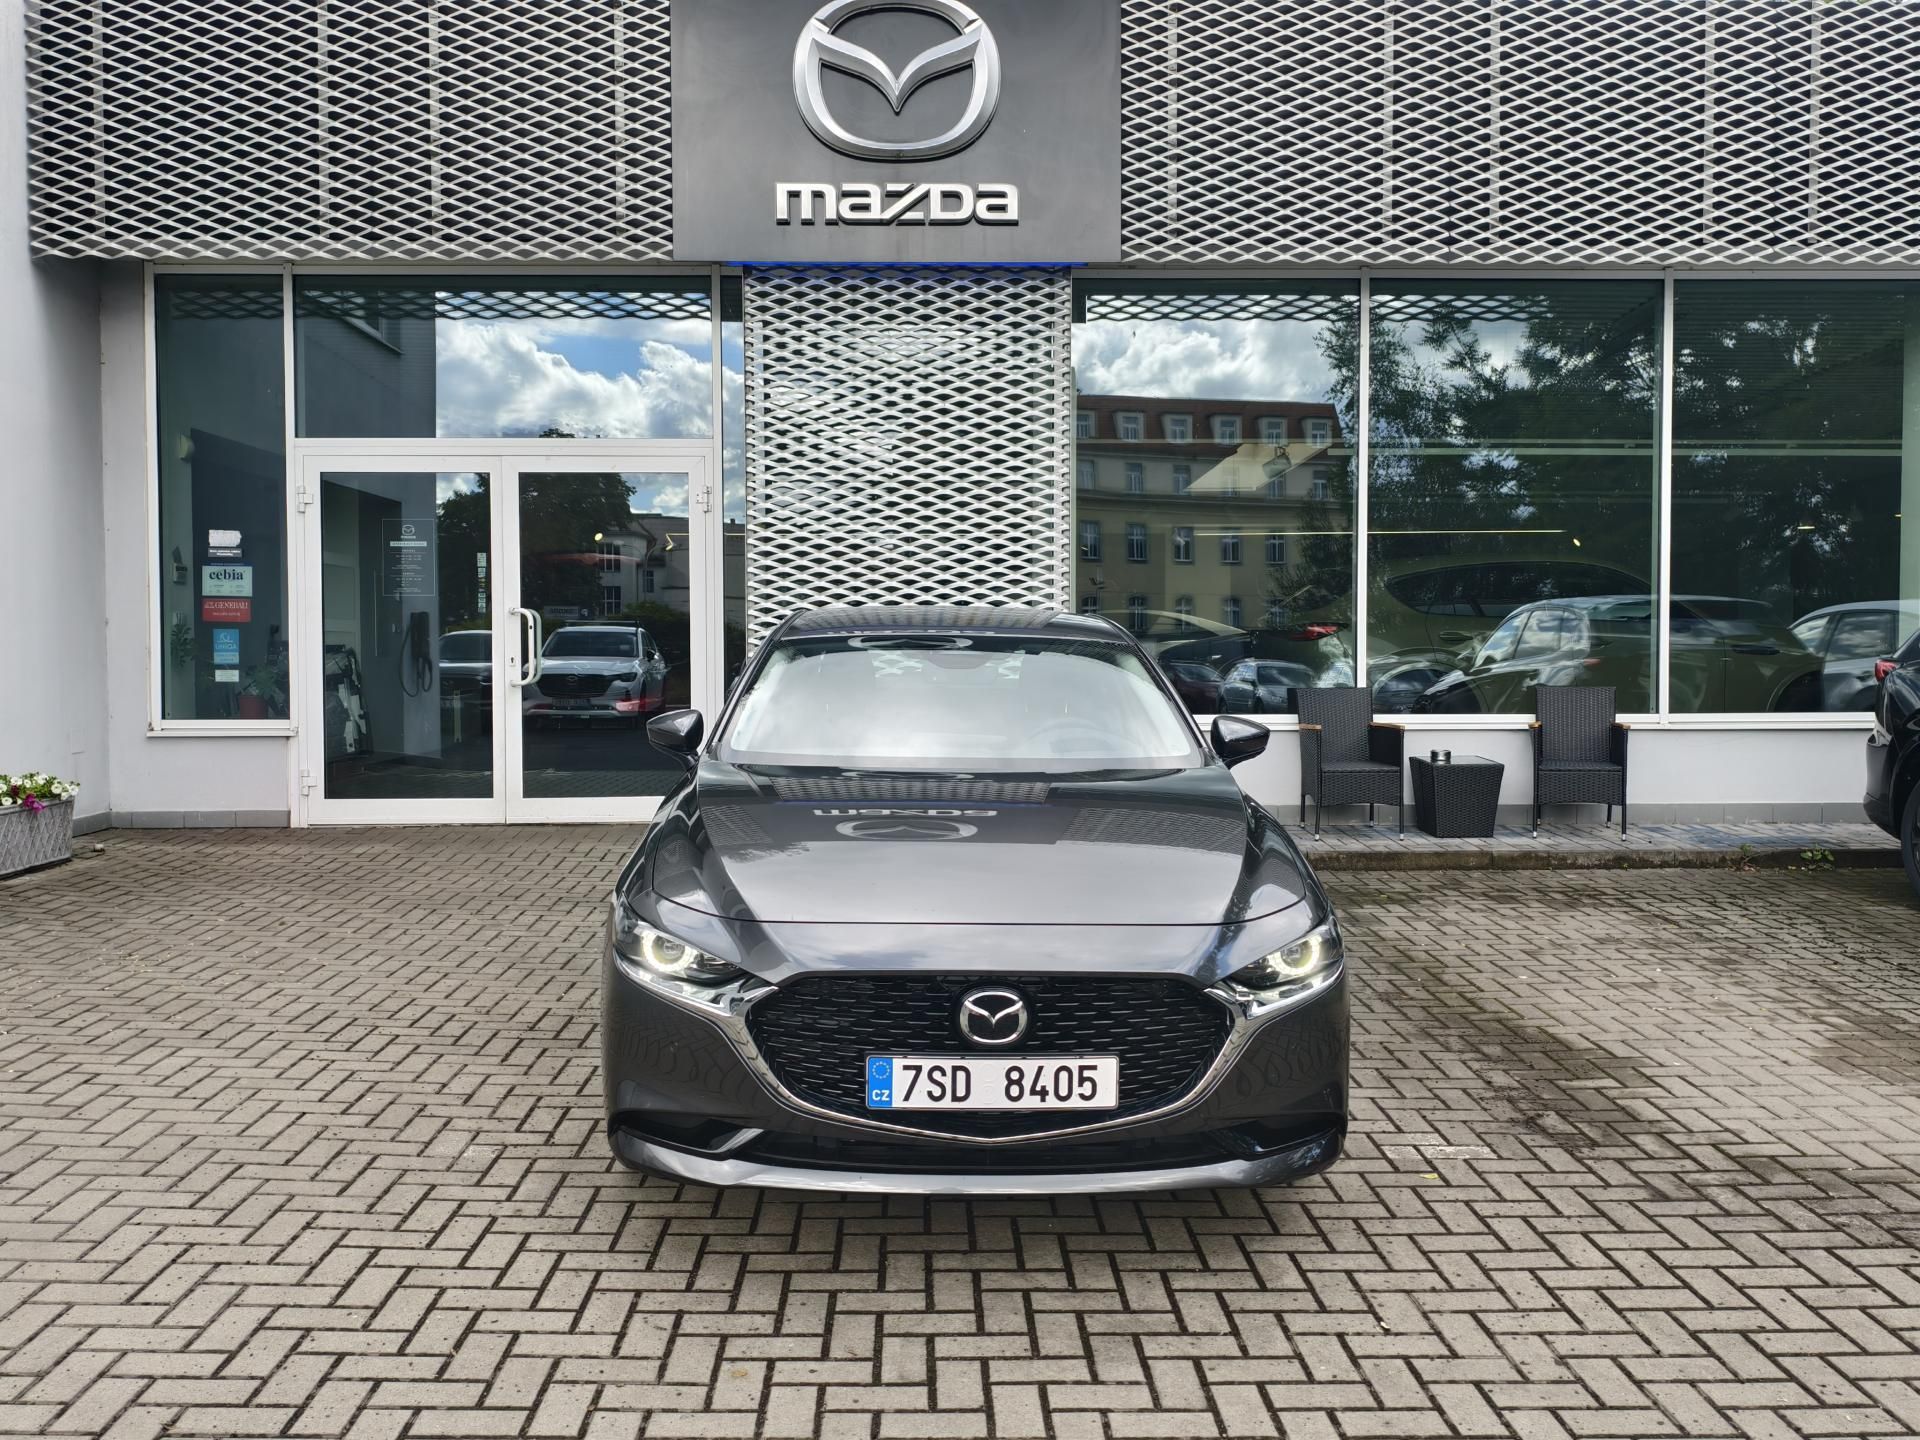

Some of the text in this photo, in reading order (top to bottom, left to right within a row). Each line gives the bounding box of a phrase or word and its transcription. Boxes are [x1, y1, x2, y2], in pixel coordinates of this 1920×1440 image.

[209, 569, 244, 580] cebia
[214, 601, 248, 609] GENERALI
[902, 1064, 1098, 1102] 7SD 8405
[872, 1089, 889, 1101] CZ
